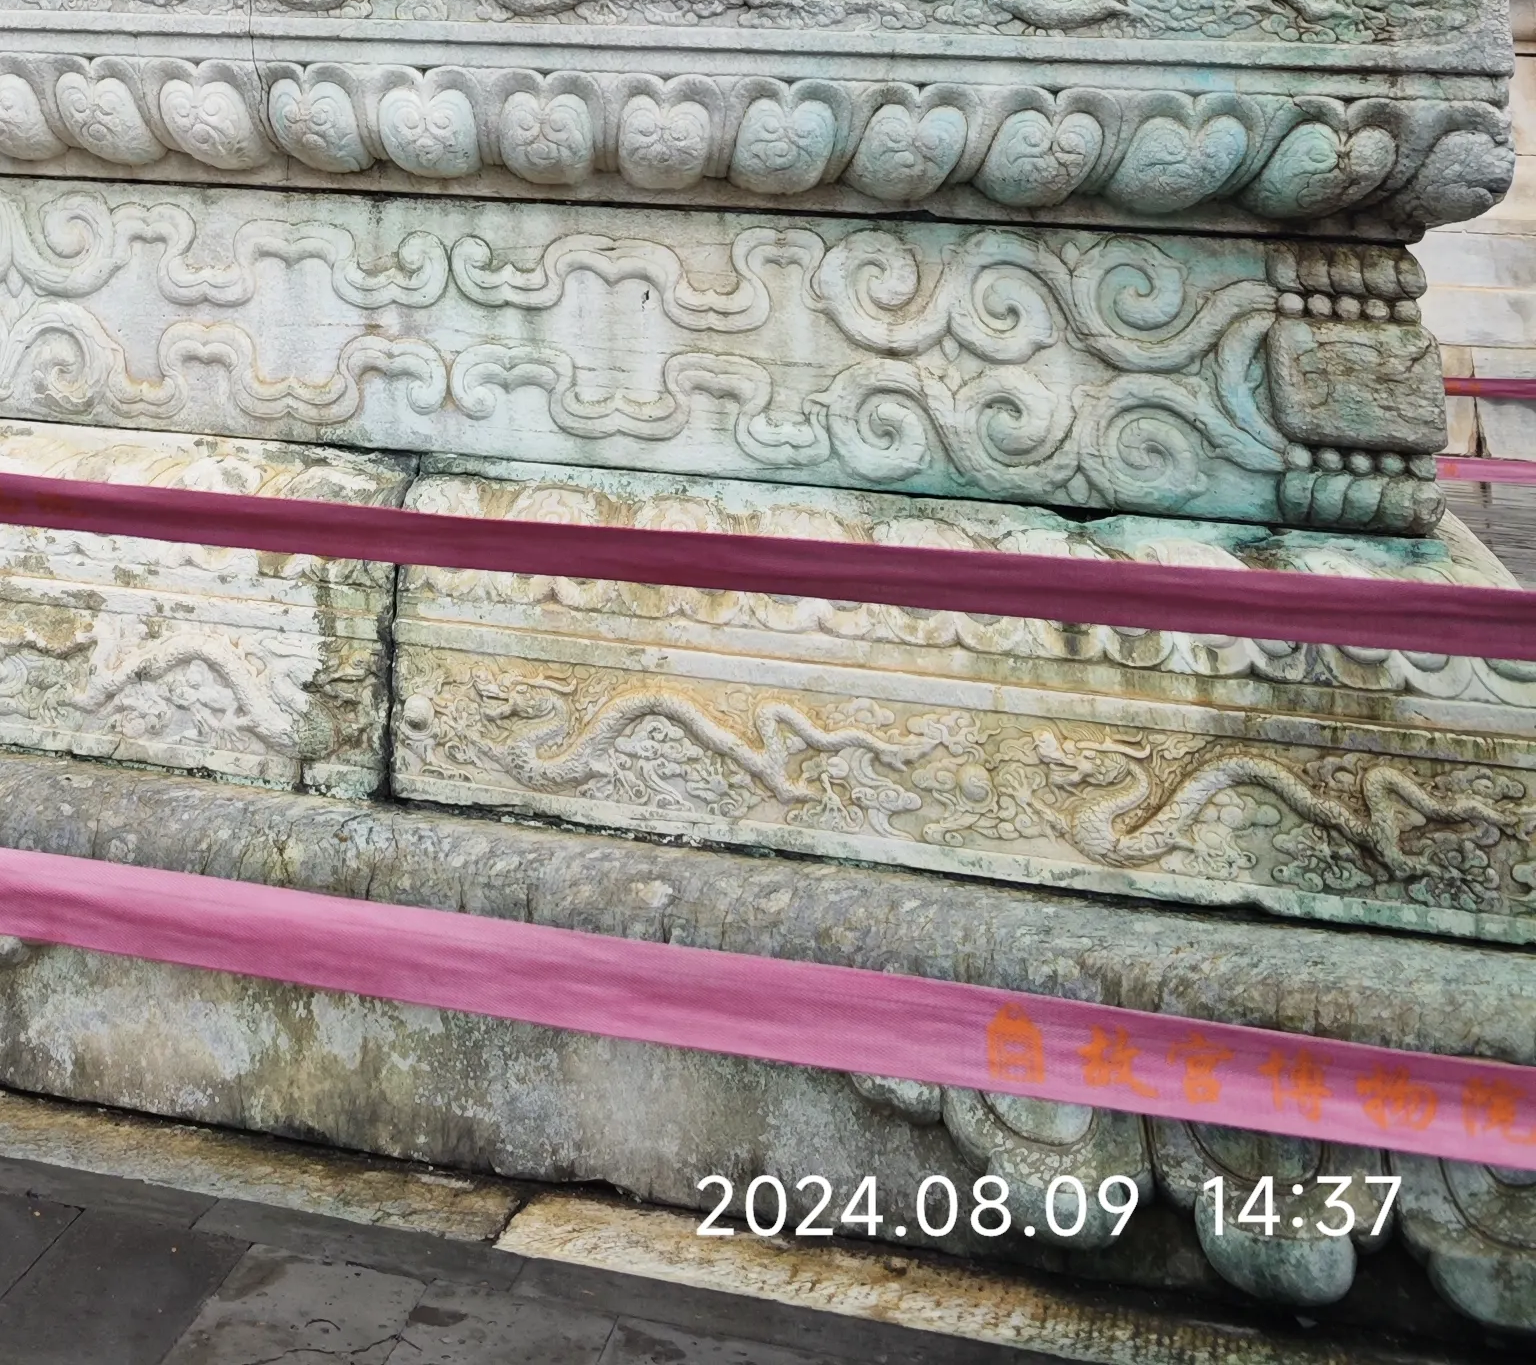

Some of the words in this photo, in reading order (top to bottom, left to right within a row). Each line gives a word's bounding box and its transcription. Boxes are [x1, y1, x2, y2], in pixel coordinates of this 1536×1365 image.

[1075, 1023, 1536, 1145] 故宫博物院
